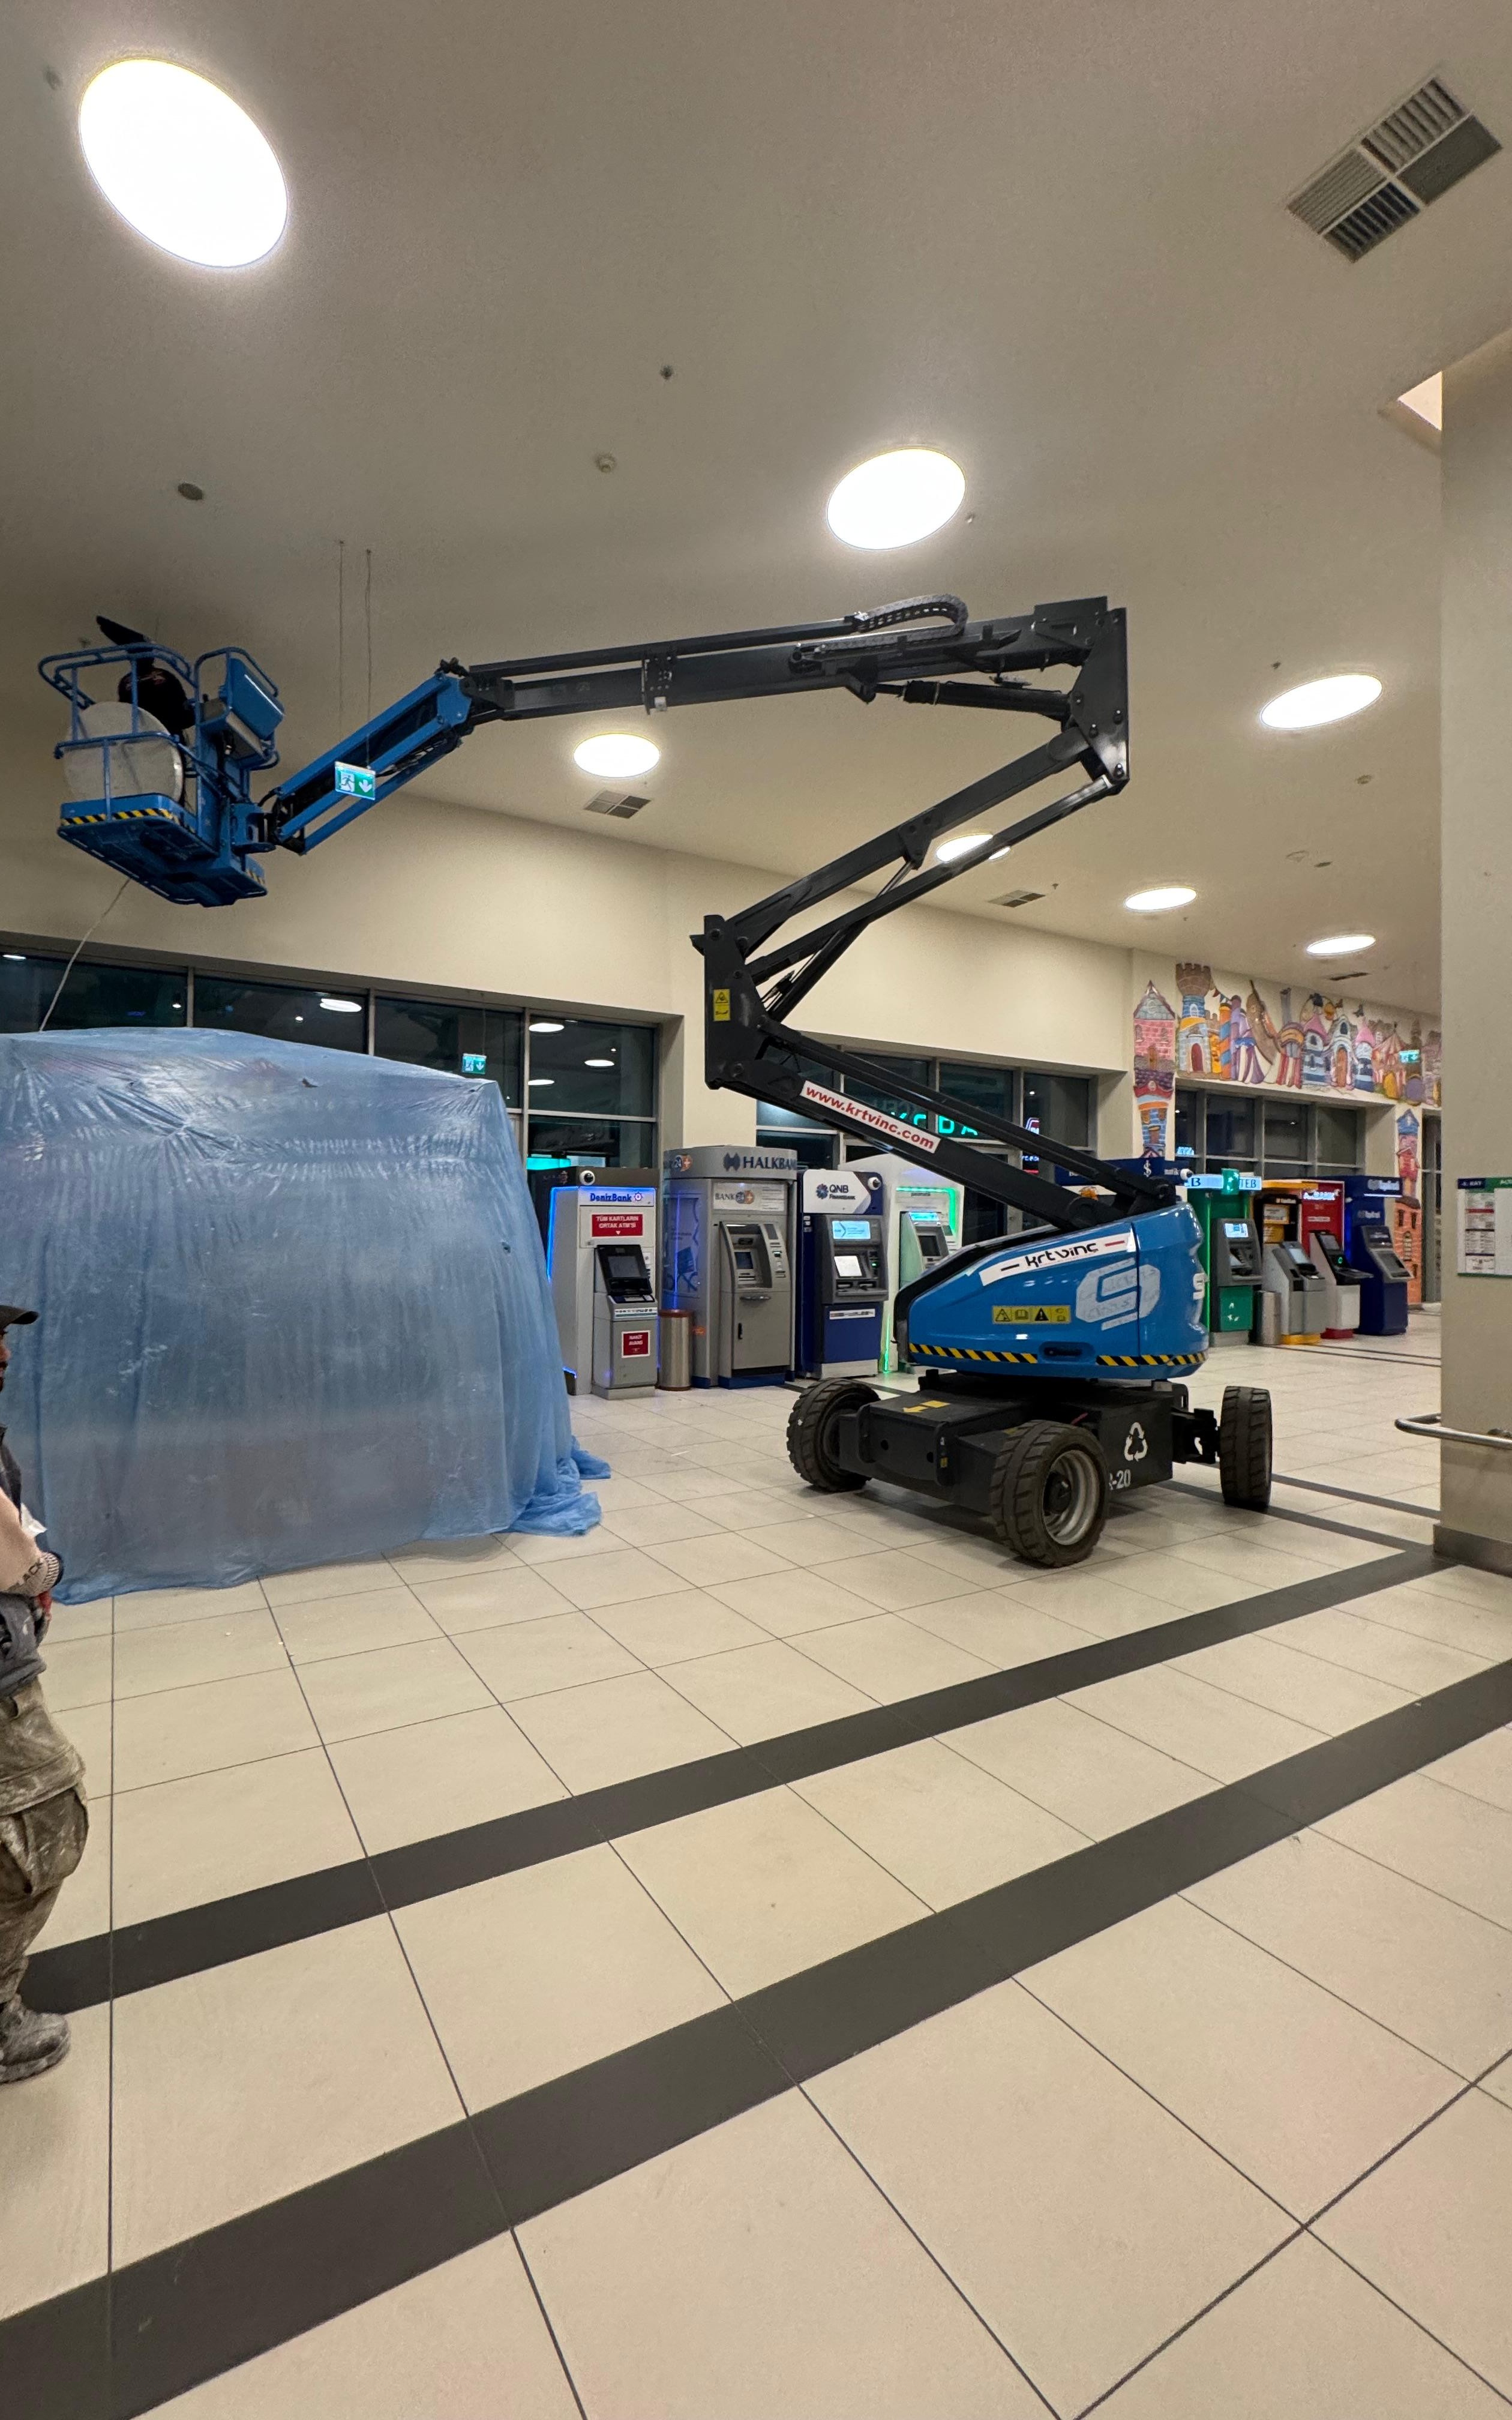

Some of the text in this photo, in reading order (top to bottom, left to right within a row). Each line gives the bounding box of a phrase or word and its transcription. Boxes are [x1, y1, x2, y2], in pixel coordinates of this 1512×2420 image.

[806, 1085, 934, 1150] www.krtvinc.com
[1240, 1179, 1256, 1188] TEB
[829, 1184, 849, 1193] QNB
[590, 1193, 632, 1202] DenizBank
